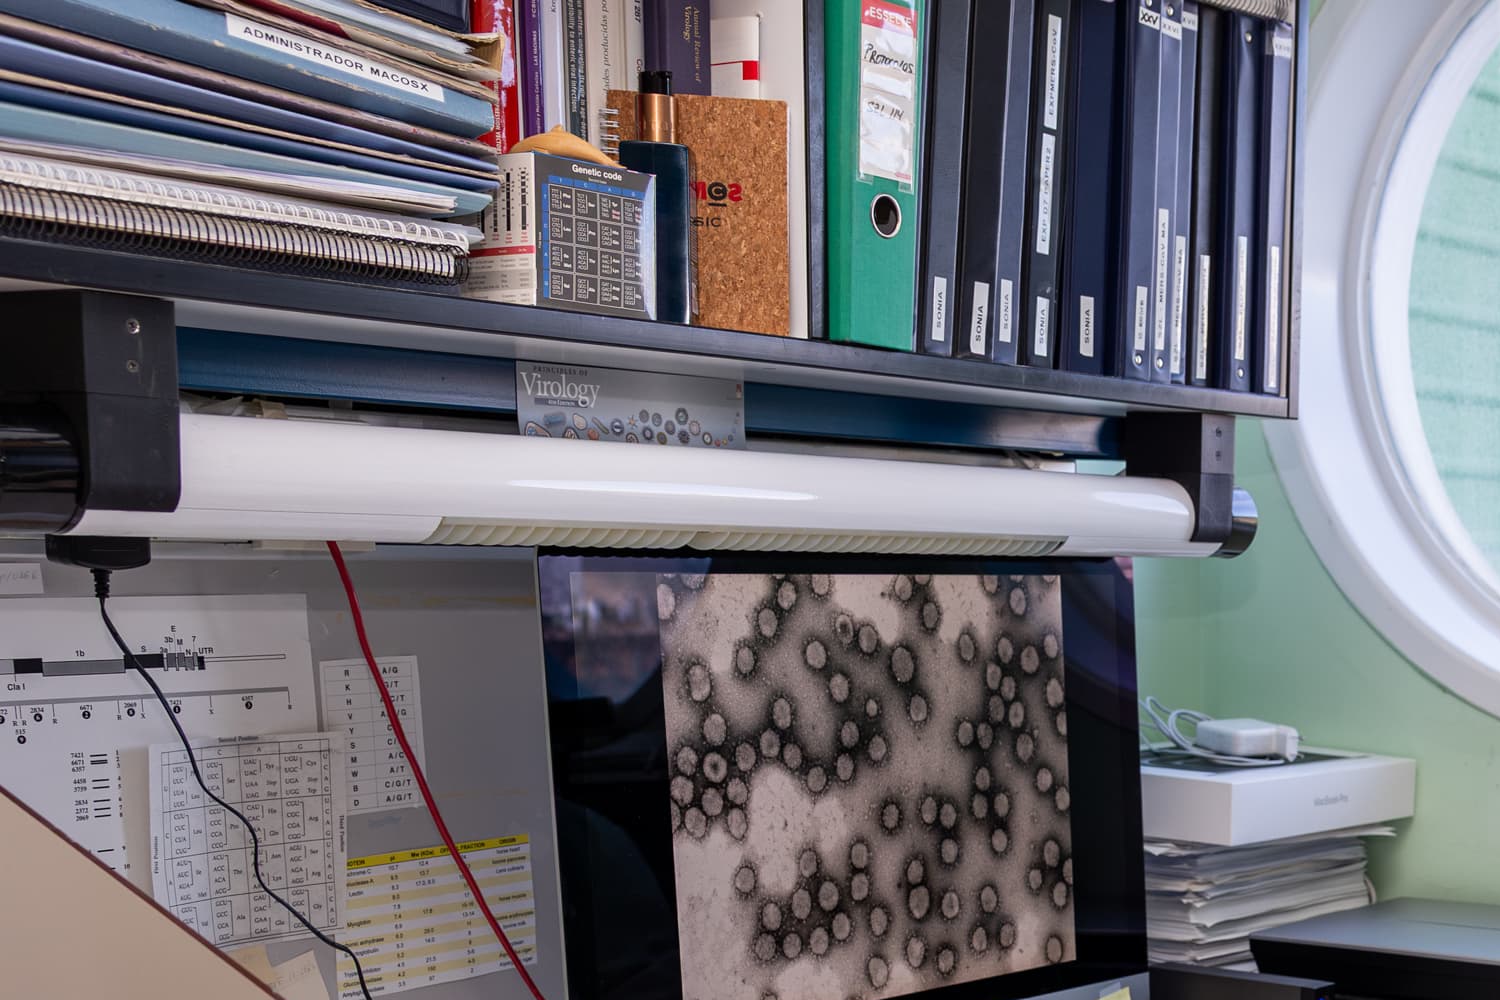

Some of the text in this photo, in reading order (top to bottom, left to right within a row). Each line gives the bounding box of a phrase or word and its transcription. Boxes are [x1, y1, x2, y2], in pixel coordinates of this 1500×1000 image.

[682, 5, 692, 42] Virology
[693, 7, 702, 38] Annual
[869, 6, 912, 27] ESSELE
[243, 26, 430, 92] ADMINISTRADOR MACOSX
[600, 15, 611, 66] producidas
[572, 163, 602, 179] Genetic
[603, 171, 623, 182] code
[975, 305, 984, 342] SONIA
[520, 371, 600, 408] Virology
[7, 683, 21, 691] Cla
